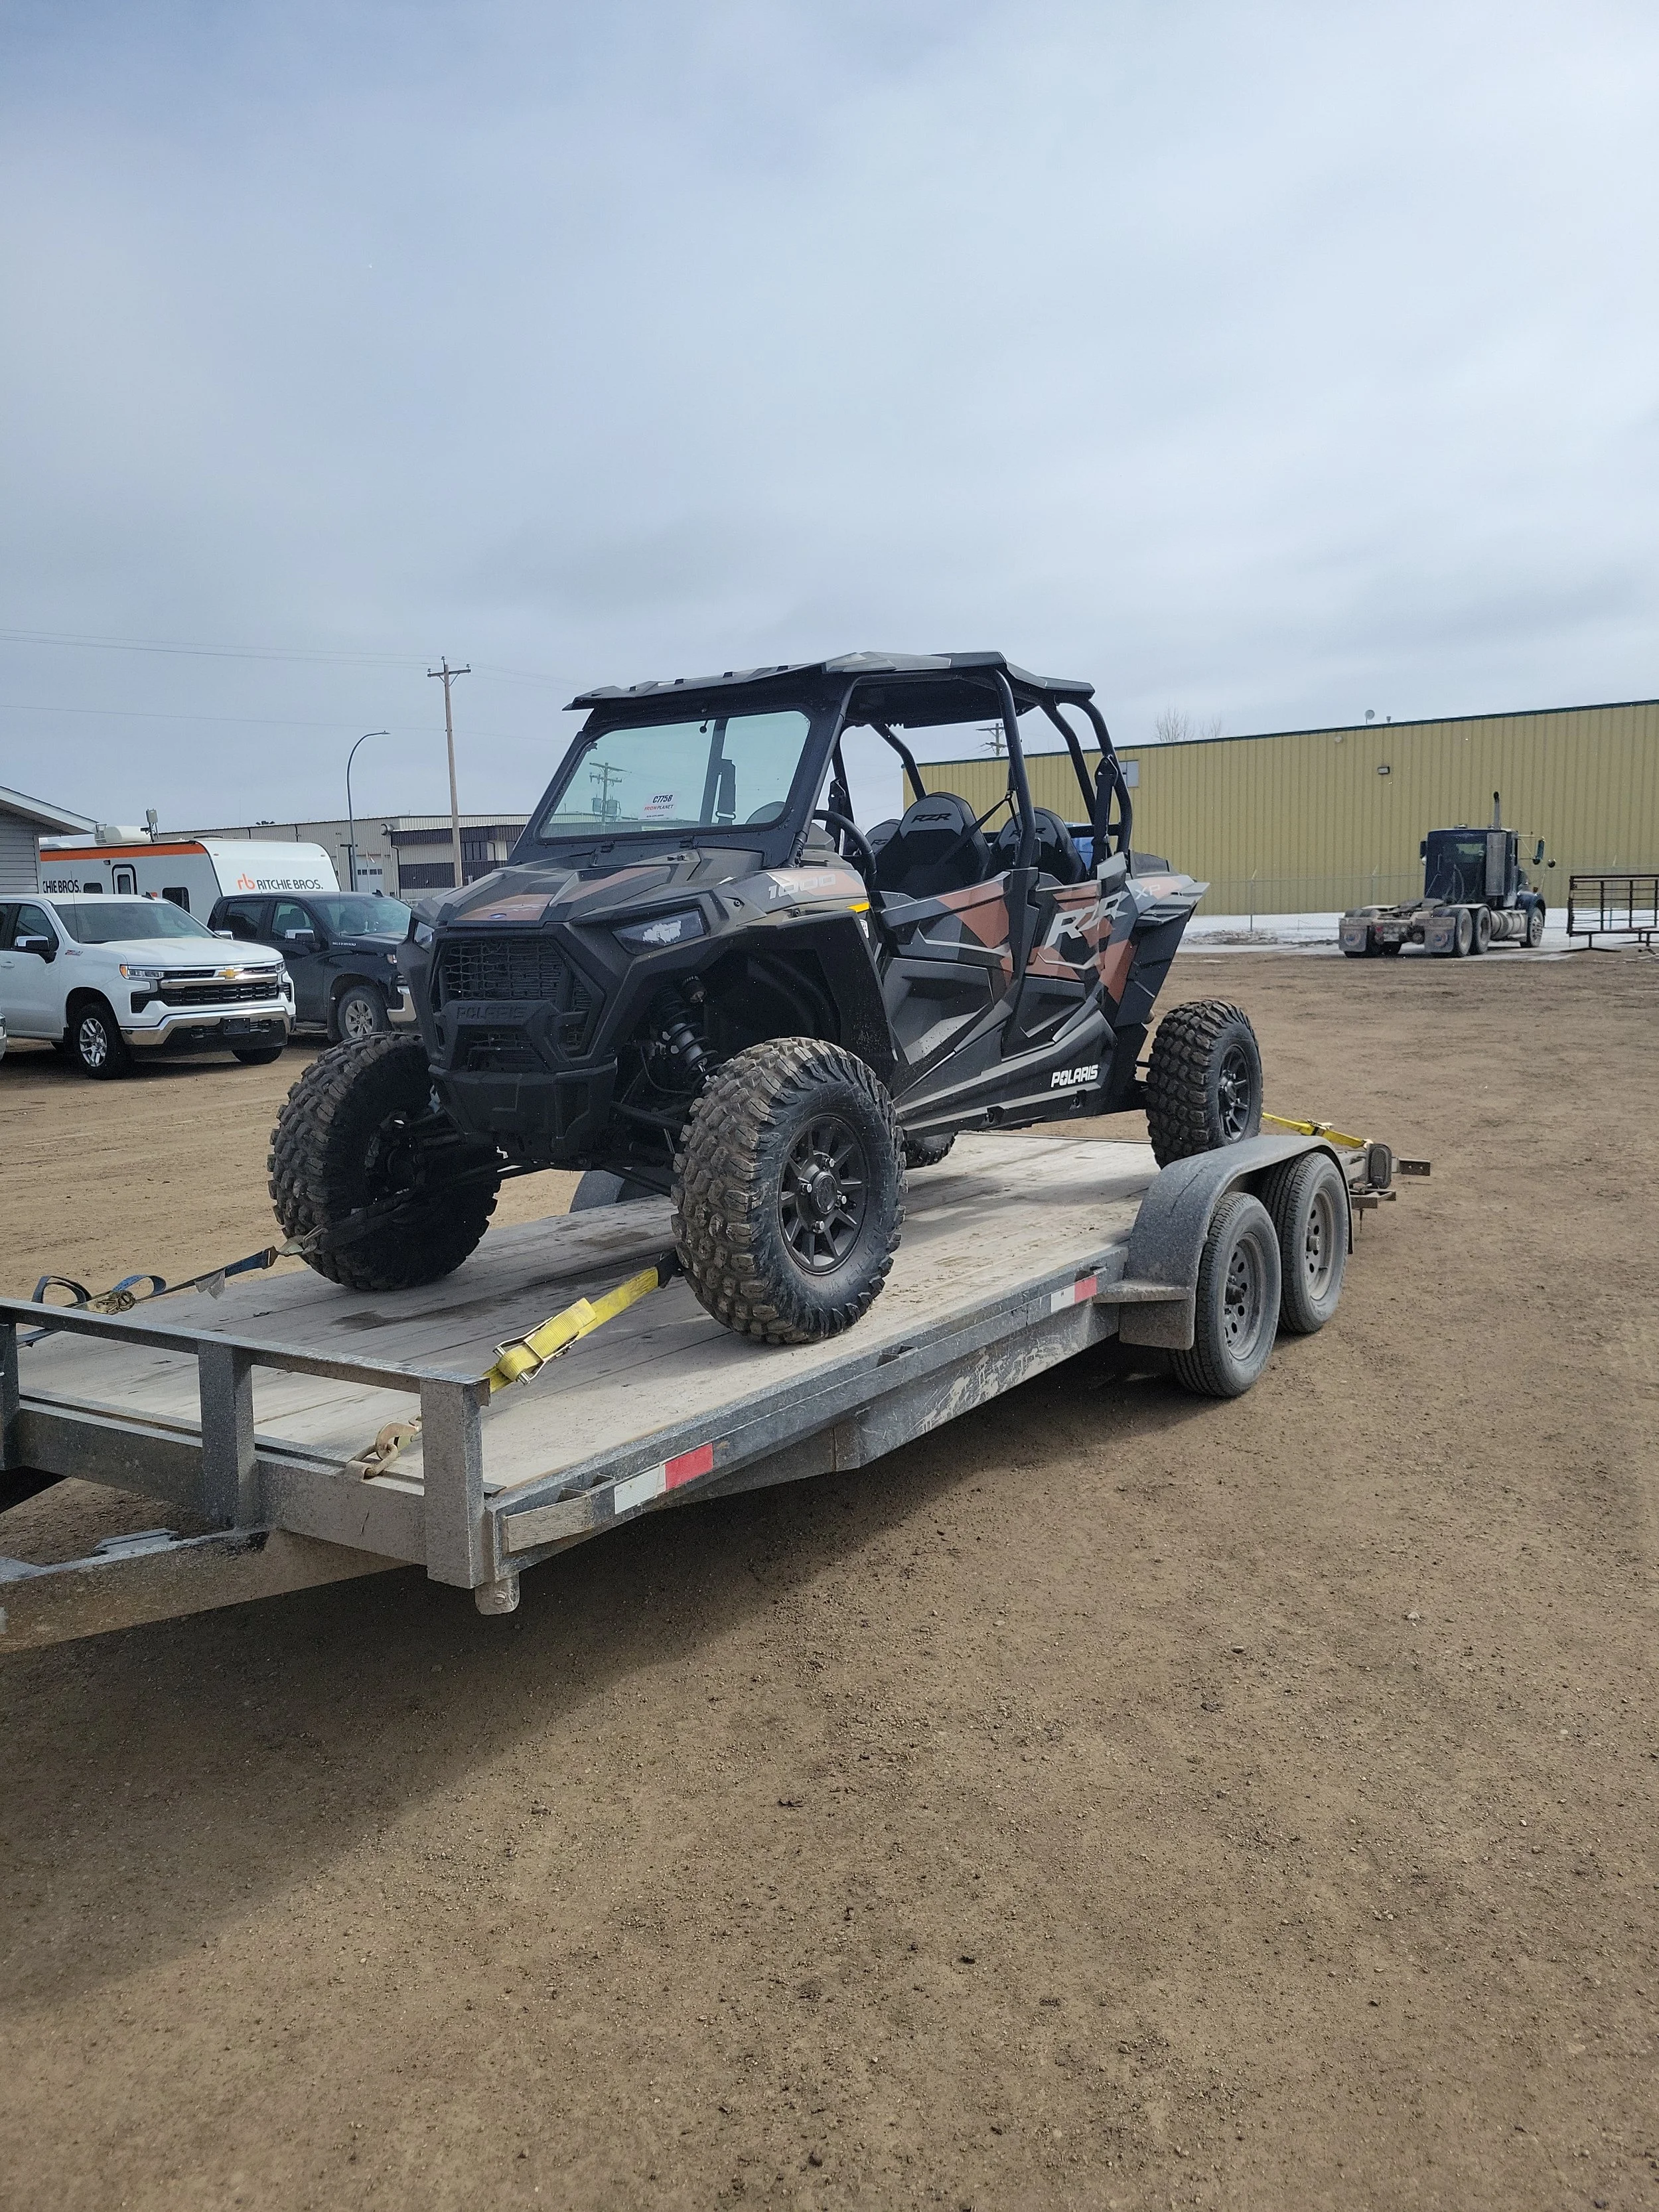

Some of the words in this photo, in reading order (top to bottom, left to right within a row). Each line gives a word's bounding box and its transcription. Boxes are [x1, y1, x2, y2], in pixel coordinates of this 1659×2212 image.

[911, 813, 952, 824] RZR
[1009, 828, 1046, 838] RR
[58, 879, 81, 893] BROS.
[256, 879, 293, 890] RITCHIE
[293, 879, 324, 890] BROS.
[768, 874, 836, 899] 1000
[1134, 884, 1161, 900] XP
[1044, 891, 1130, 950] RZR
[1050, 1065, 1099, 1088] POLARIS
